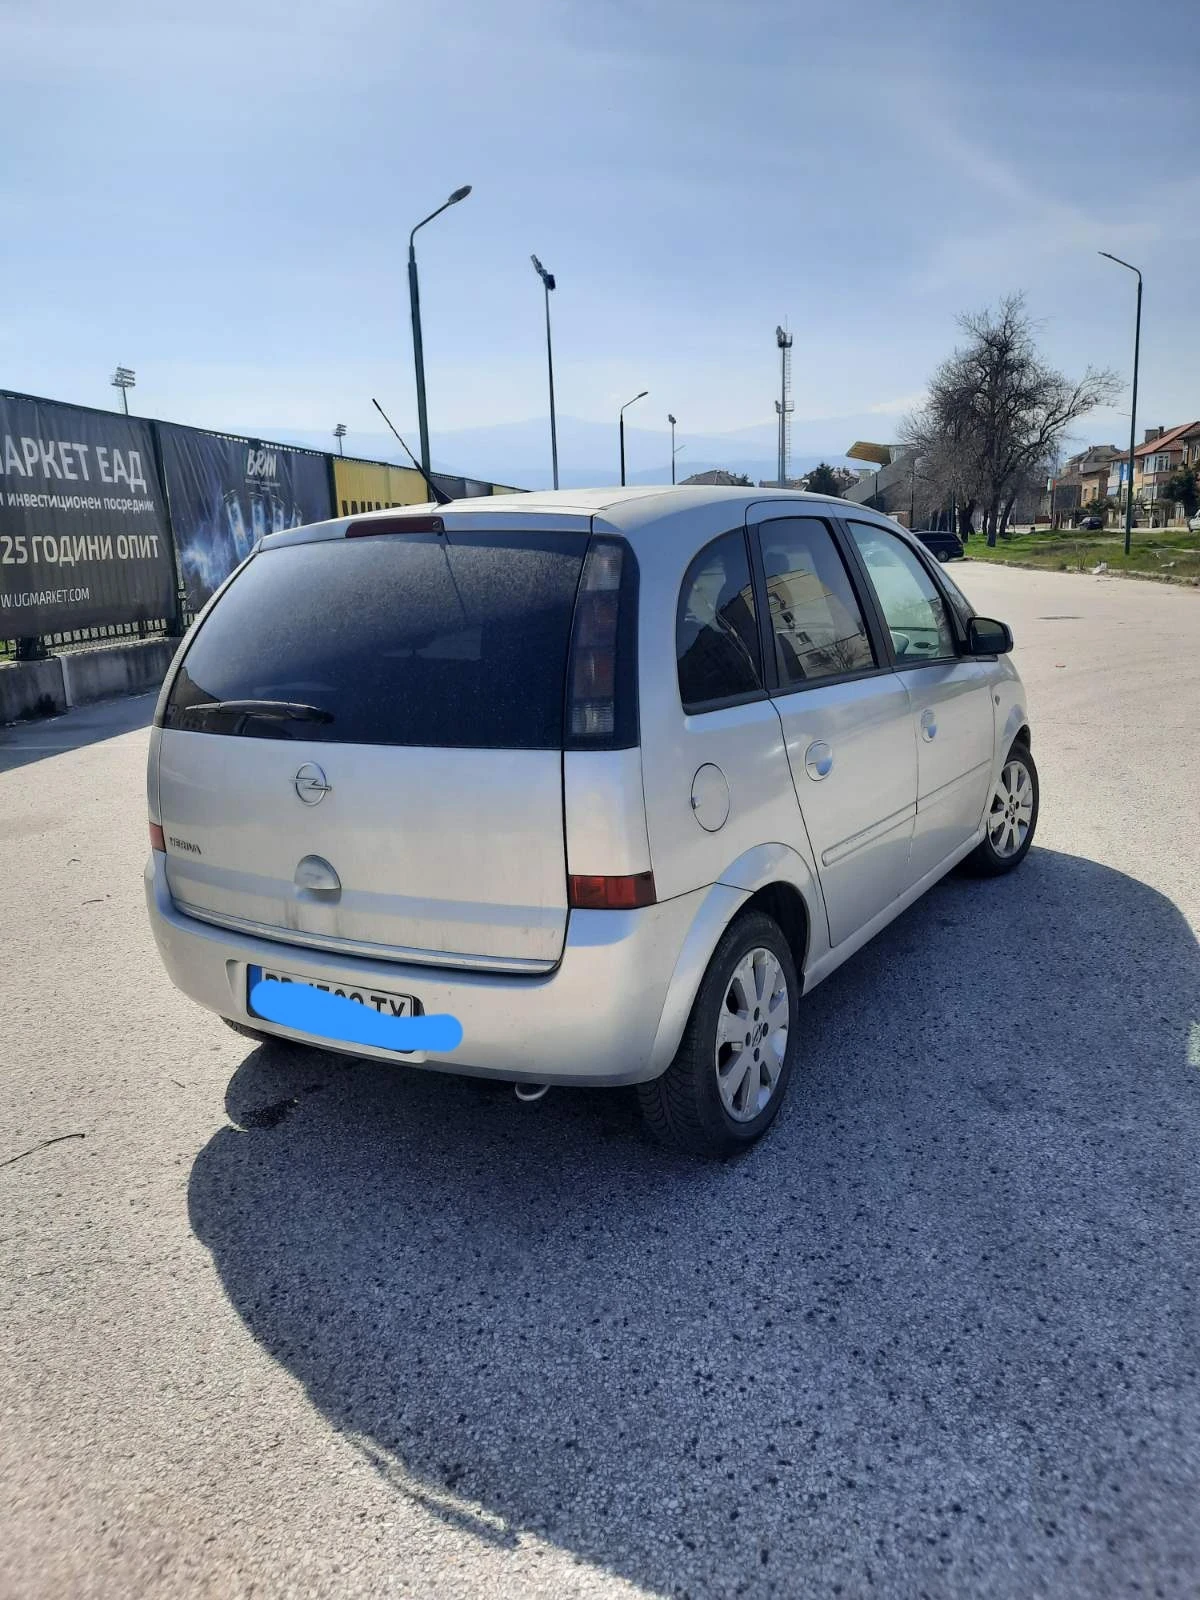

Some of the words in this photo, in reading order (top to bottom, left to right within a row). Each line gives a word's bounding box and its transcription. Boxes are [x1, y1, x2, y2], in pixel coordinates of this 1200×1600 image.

[95, 446, 148, 494] ЕАД
[7, 493, 101, 512] инвестиционен
[103, 497, 155, 514] посредник
[0, 535, 28, 564] 25
[31, 535, 113, 567] ГОДИНИ
[117, 535, 158, 560] ОПИТ
